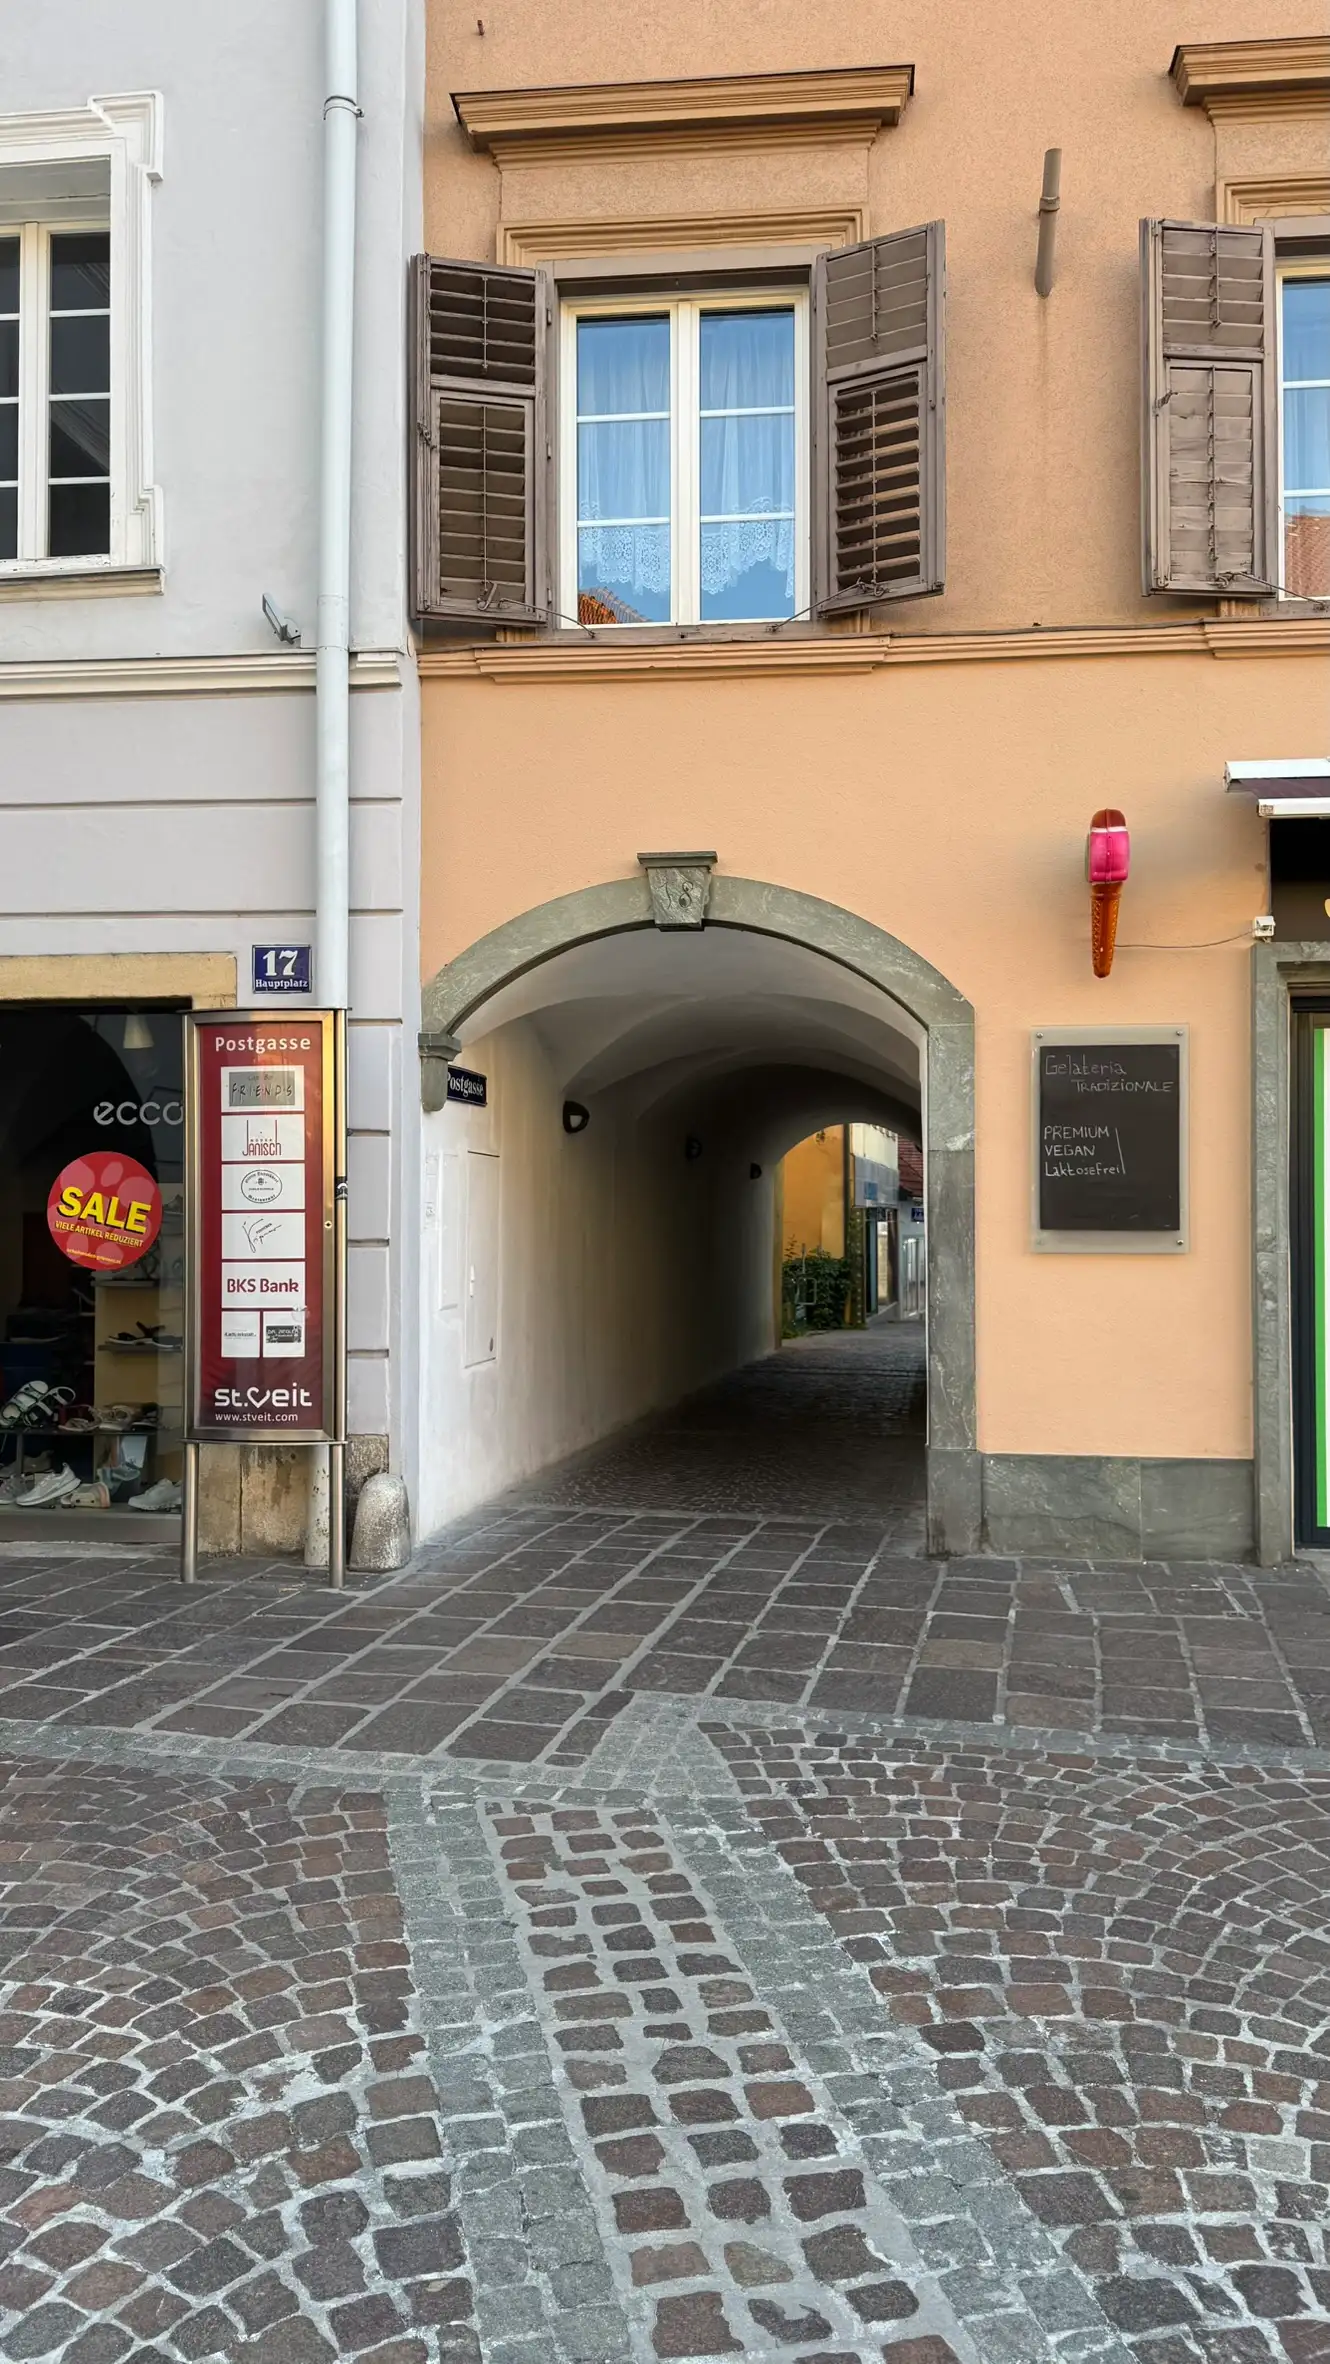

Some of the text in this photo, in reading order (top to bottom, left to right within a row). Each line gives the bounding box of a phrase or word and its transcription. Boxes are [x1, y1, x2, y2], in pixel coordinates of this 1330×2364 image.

[262, 950, 298, 976] 17
[255, 978, 308, 989] Hauptplatz
[215, 1036, 311, 1054] Postgasse
[1045, 1054, 1127, 1076] Gelateria
[93, 1101, 183, 1125] ecco
[1043, 1125, 1110, 1140] PREMIUM
[1044, 1144, 1096, 1156] VEGAN
[57, 1186, 152, 1235] SALE
[55, 1220, 143, 1247] VIELE ARTIKEL REDUZIERT
[227, 1278, 299, 1293] BKS Bank
[215, 1412, 298, 1422] www.stveit.com
